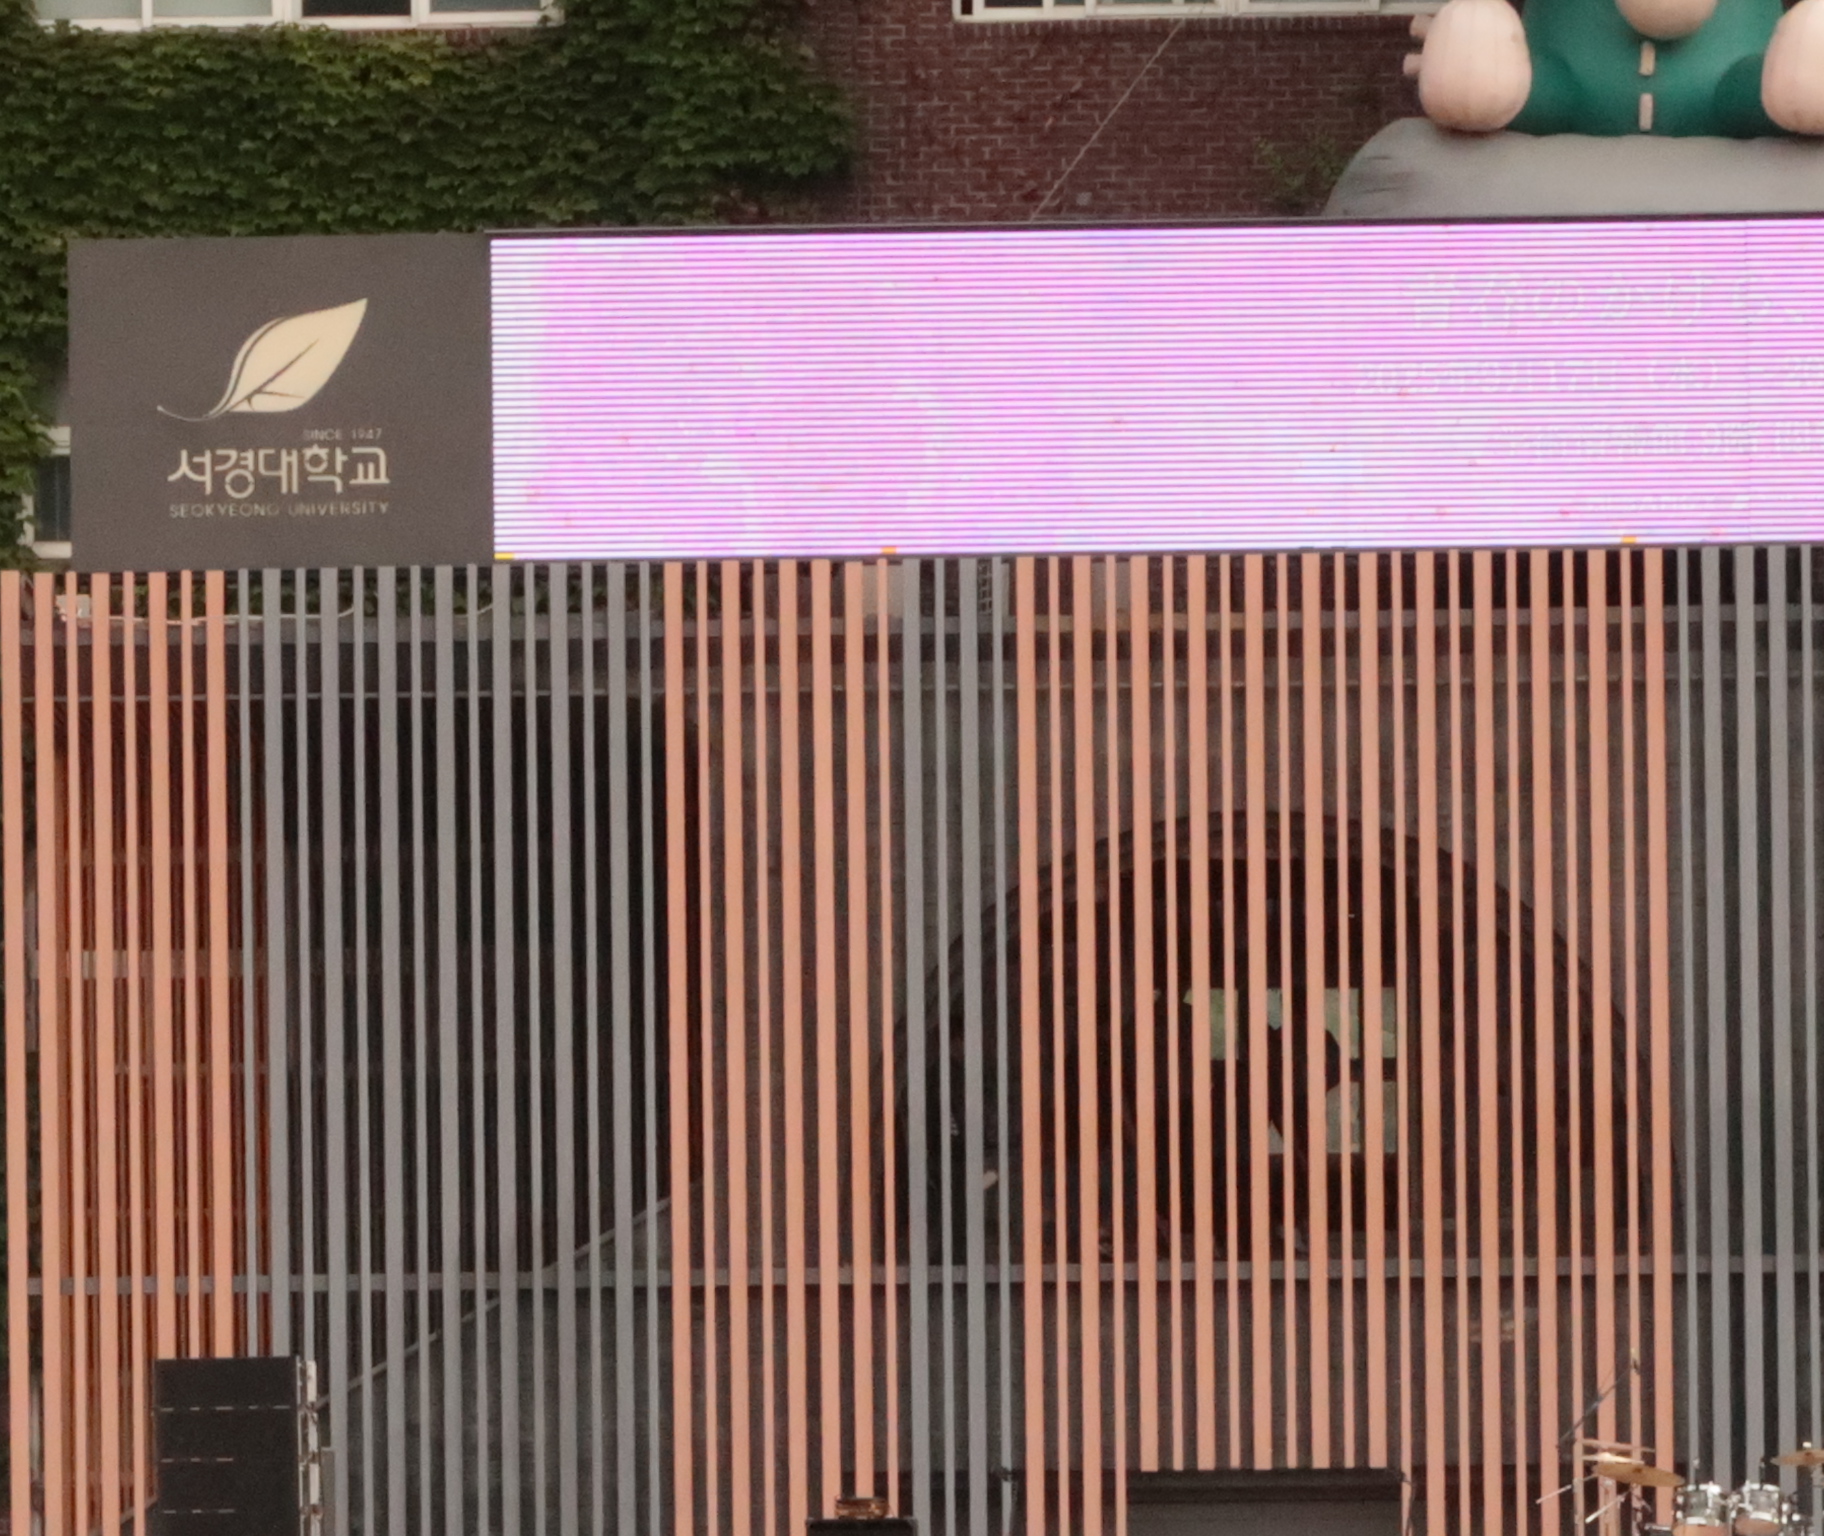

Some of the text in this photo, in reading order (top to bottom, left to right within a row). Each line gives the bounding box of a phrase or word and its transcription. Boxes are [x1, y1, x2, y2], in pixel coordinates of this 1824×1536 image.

[304, 427, 382, 441] SINCE 1947
[167, 443, 390, 499] 서경대학교
[169, 502, 389, 518] SEOKYEONG UNIVERSITY
